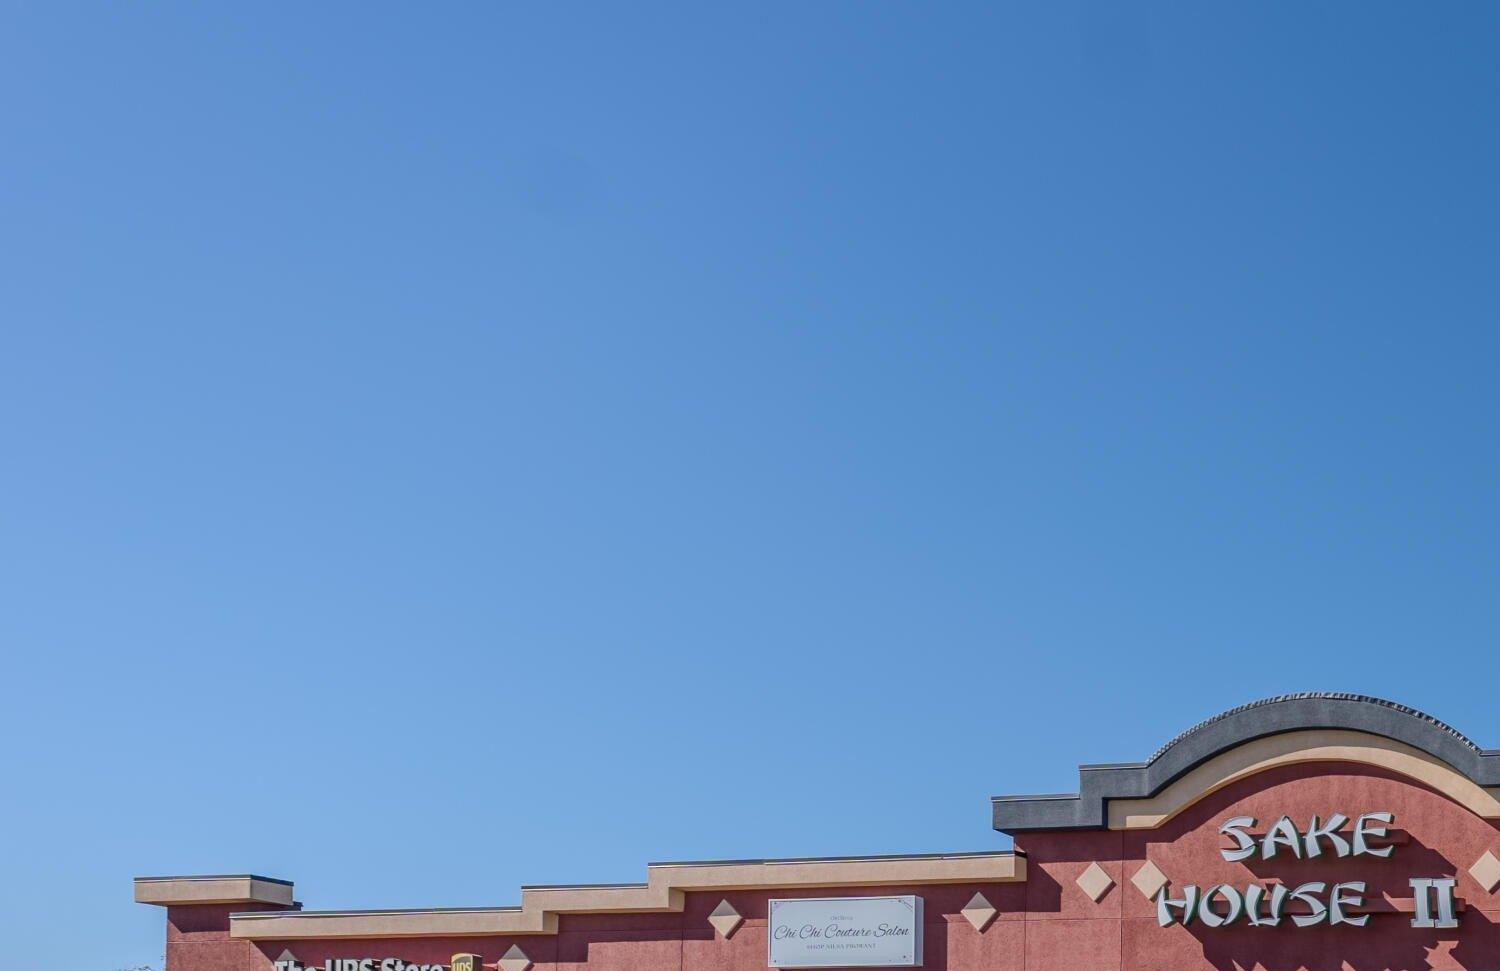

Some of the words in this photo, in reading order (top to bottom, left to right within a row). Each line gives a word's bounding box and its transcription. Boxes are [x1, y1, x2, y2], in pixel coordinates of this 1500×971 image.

[1219, 812, 1395, 861] SAKE
[1157, 881, 1370, 928] HOUSE
[1408, 878, 1458, 928] II
[774, 925, 797, 940] Chi
[799, 924, 823, 940] Chi
[824, 923, 872, 939] Couture
[872, 923, 910, 938] Salon
